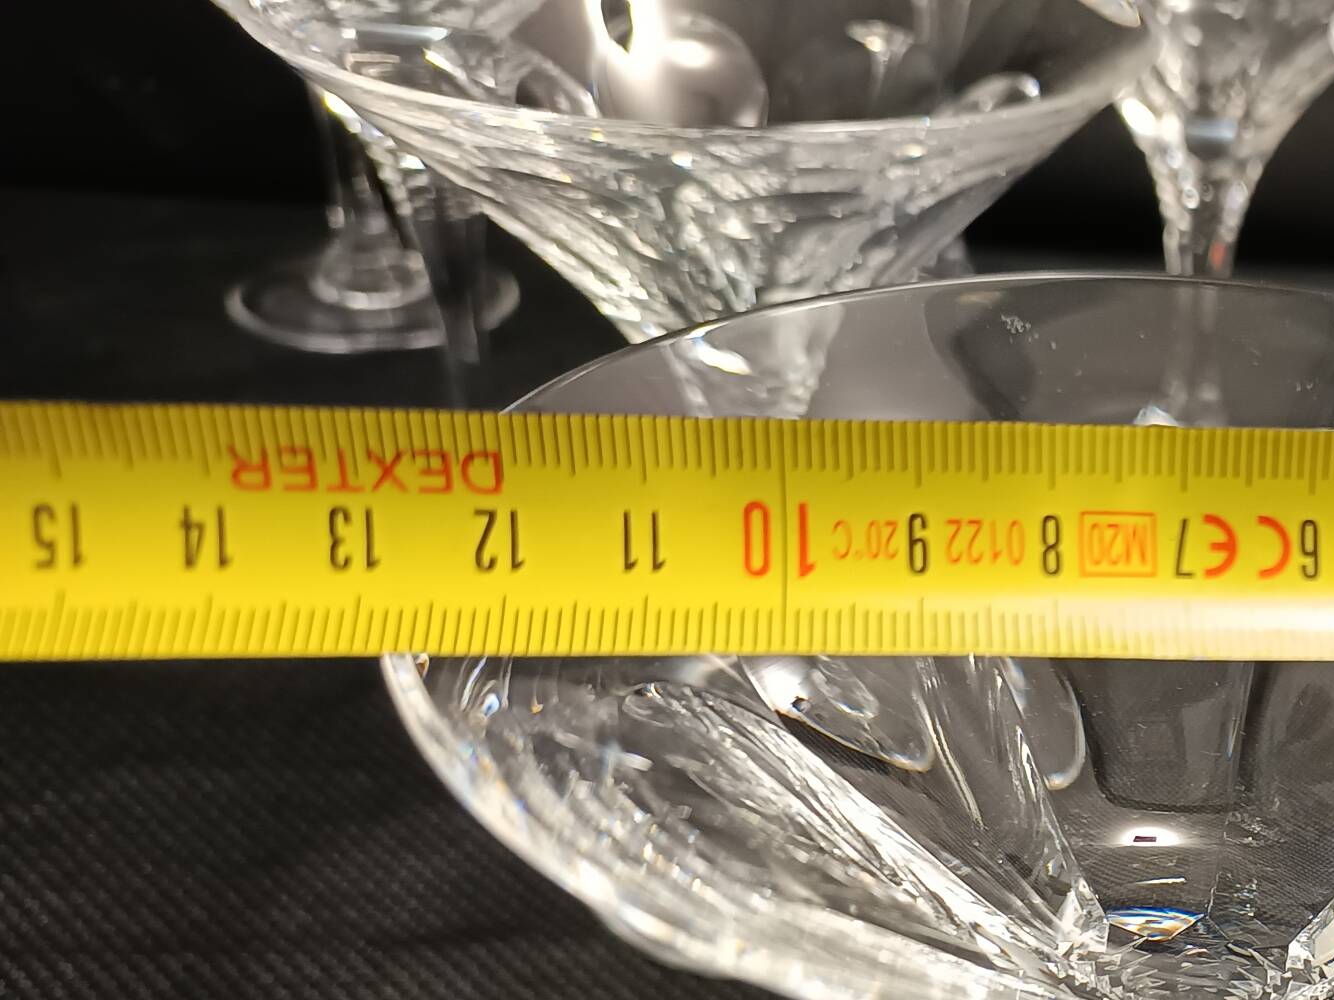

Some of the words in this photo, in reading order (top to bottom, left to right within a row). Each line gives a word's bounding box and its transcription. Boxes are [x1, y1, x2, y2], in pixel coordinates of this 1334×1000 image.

[228, 446, 503, 495] DEXTER
[32, 503, 87, 571] 15
[178, 504, 234, 570] 14
[328, 506, 381, 572] 13
[473, 508, 525, 573] 12
[622, 510, 666, 572] 11
[743, 501, 816, 577] 10
[907, 512, 930, 575] 9
[945, 518, 1026, 566] 0122
[1041, 515, 1062, 576] 8
[1088, 522, 1148, 567] M20
[1174, 518, 1195, 579] 7
[1300, 519, 1320, 580] 6
